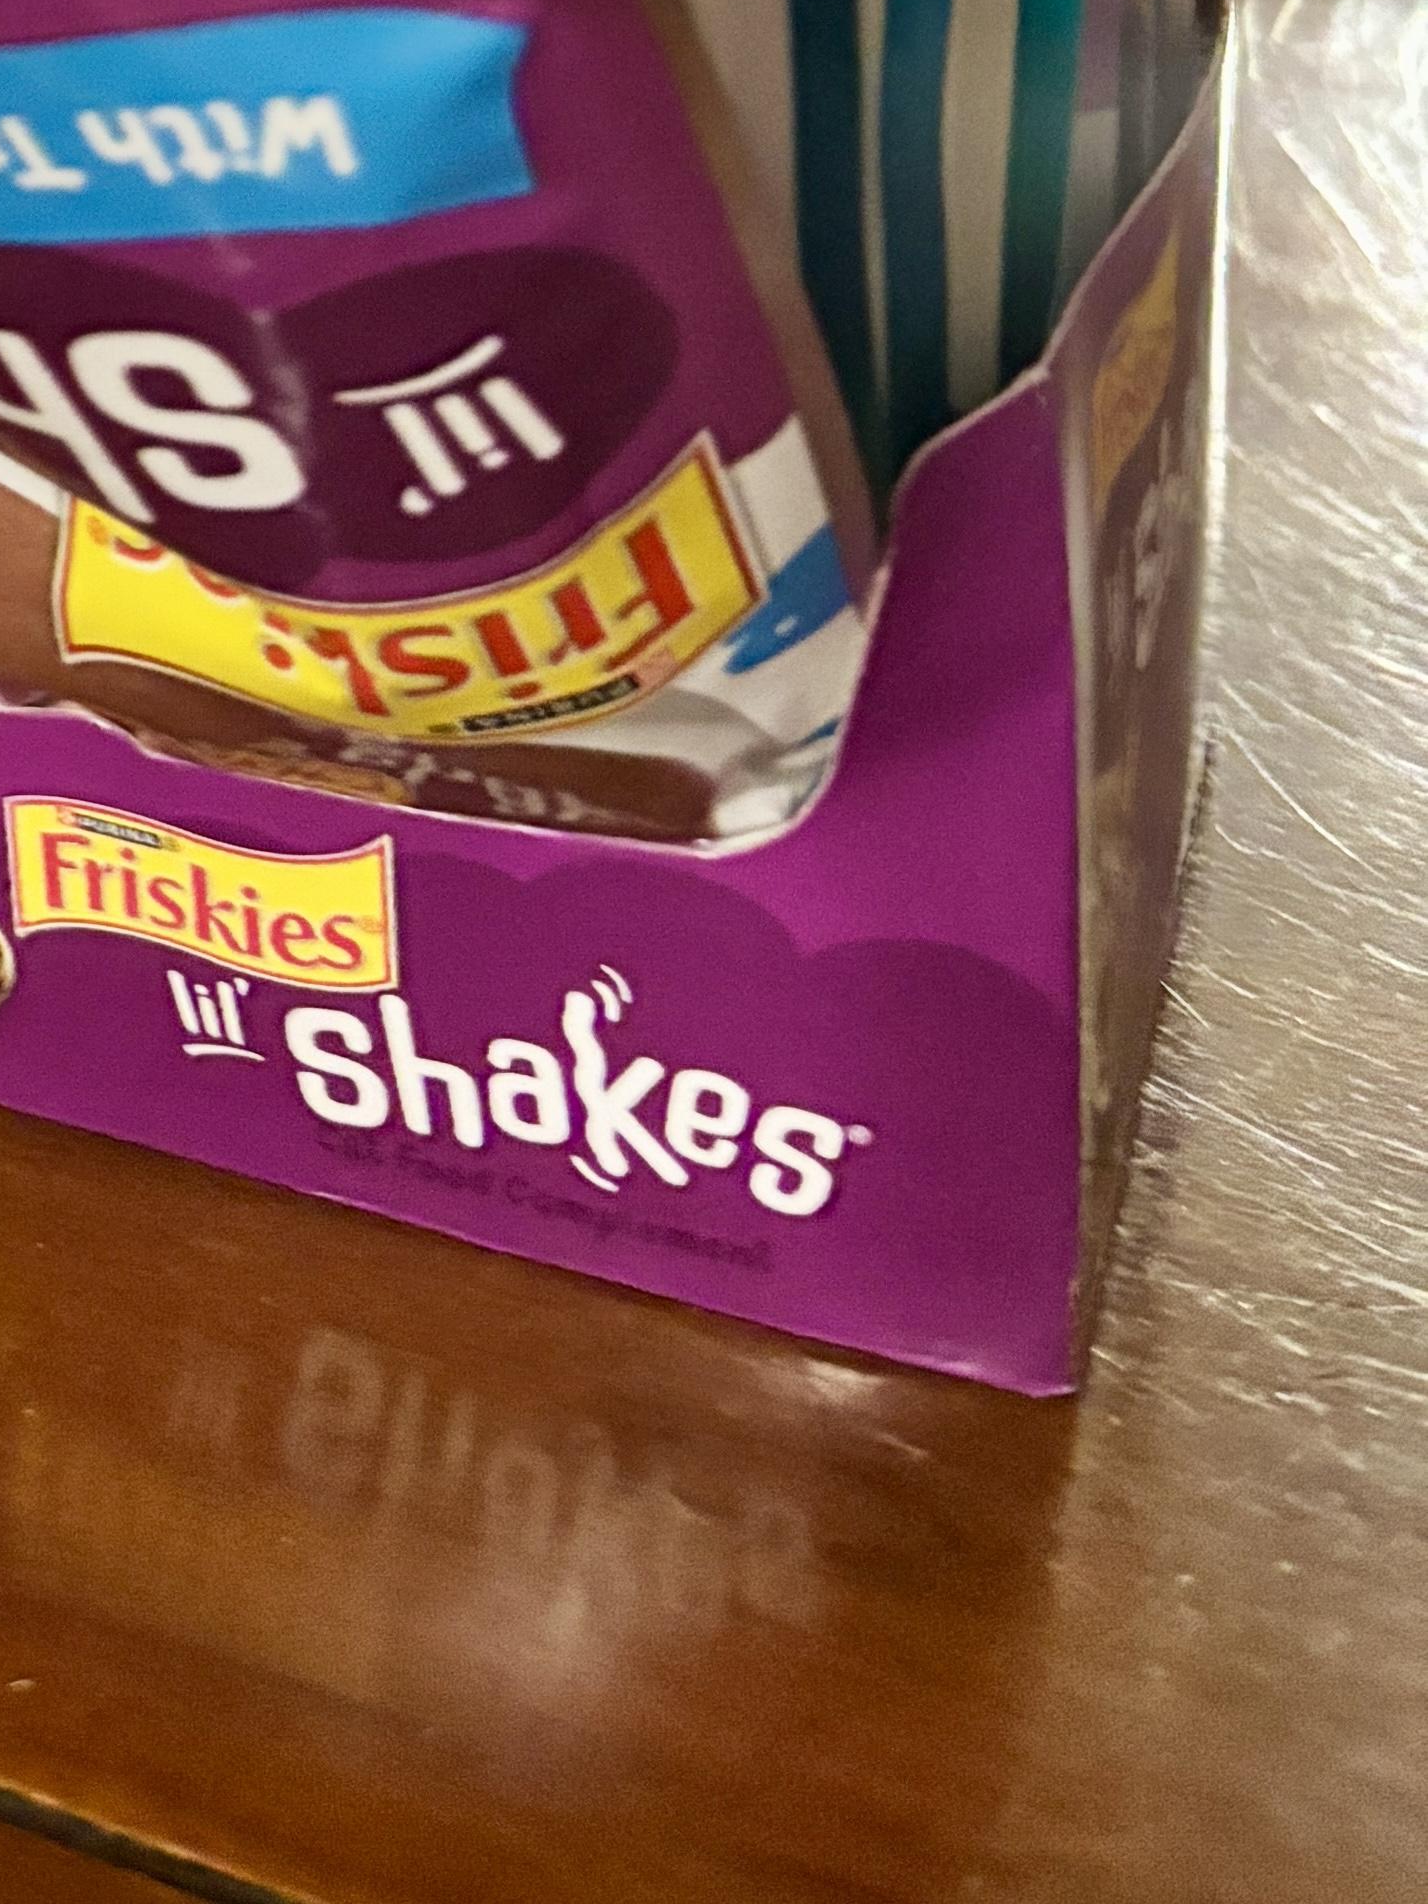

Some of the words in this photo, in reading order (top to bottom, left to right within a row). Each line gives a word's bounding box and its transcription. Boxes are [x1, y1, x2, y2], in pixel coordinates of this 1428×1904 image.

[76, 94, 358, 188] With
[41, 832, 365, 972] Friskies
[283, 989, 845, 1218] Shakes
